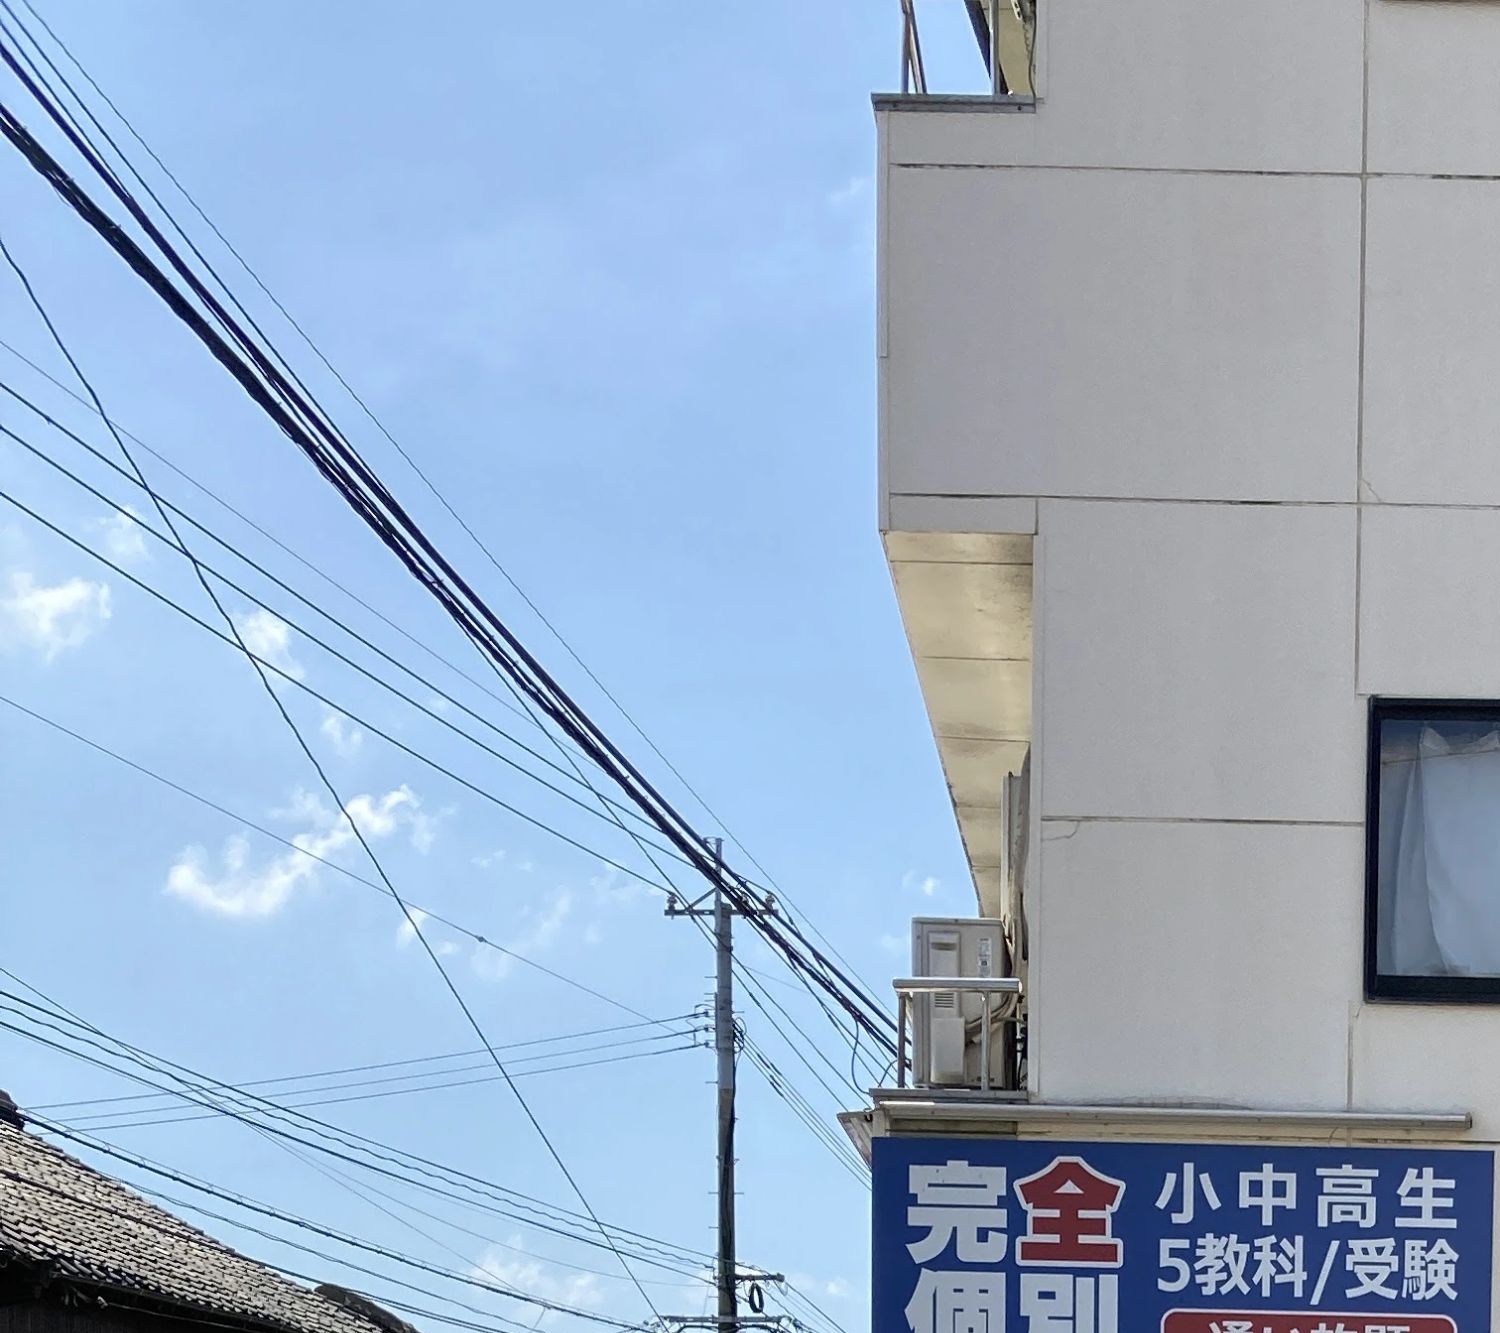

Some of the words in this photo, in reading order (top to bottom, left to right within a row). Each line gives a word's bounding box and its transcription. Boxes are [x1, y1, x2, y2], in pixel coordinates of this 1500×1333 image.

[906, 1155, 1127, 1268] 完全
[1154, 1162, 1458, 1230] 小中高生
[1157, 1233, 1460, 1306] 5教科/受験
